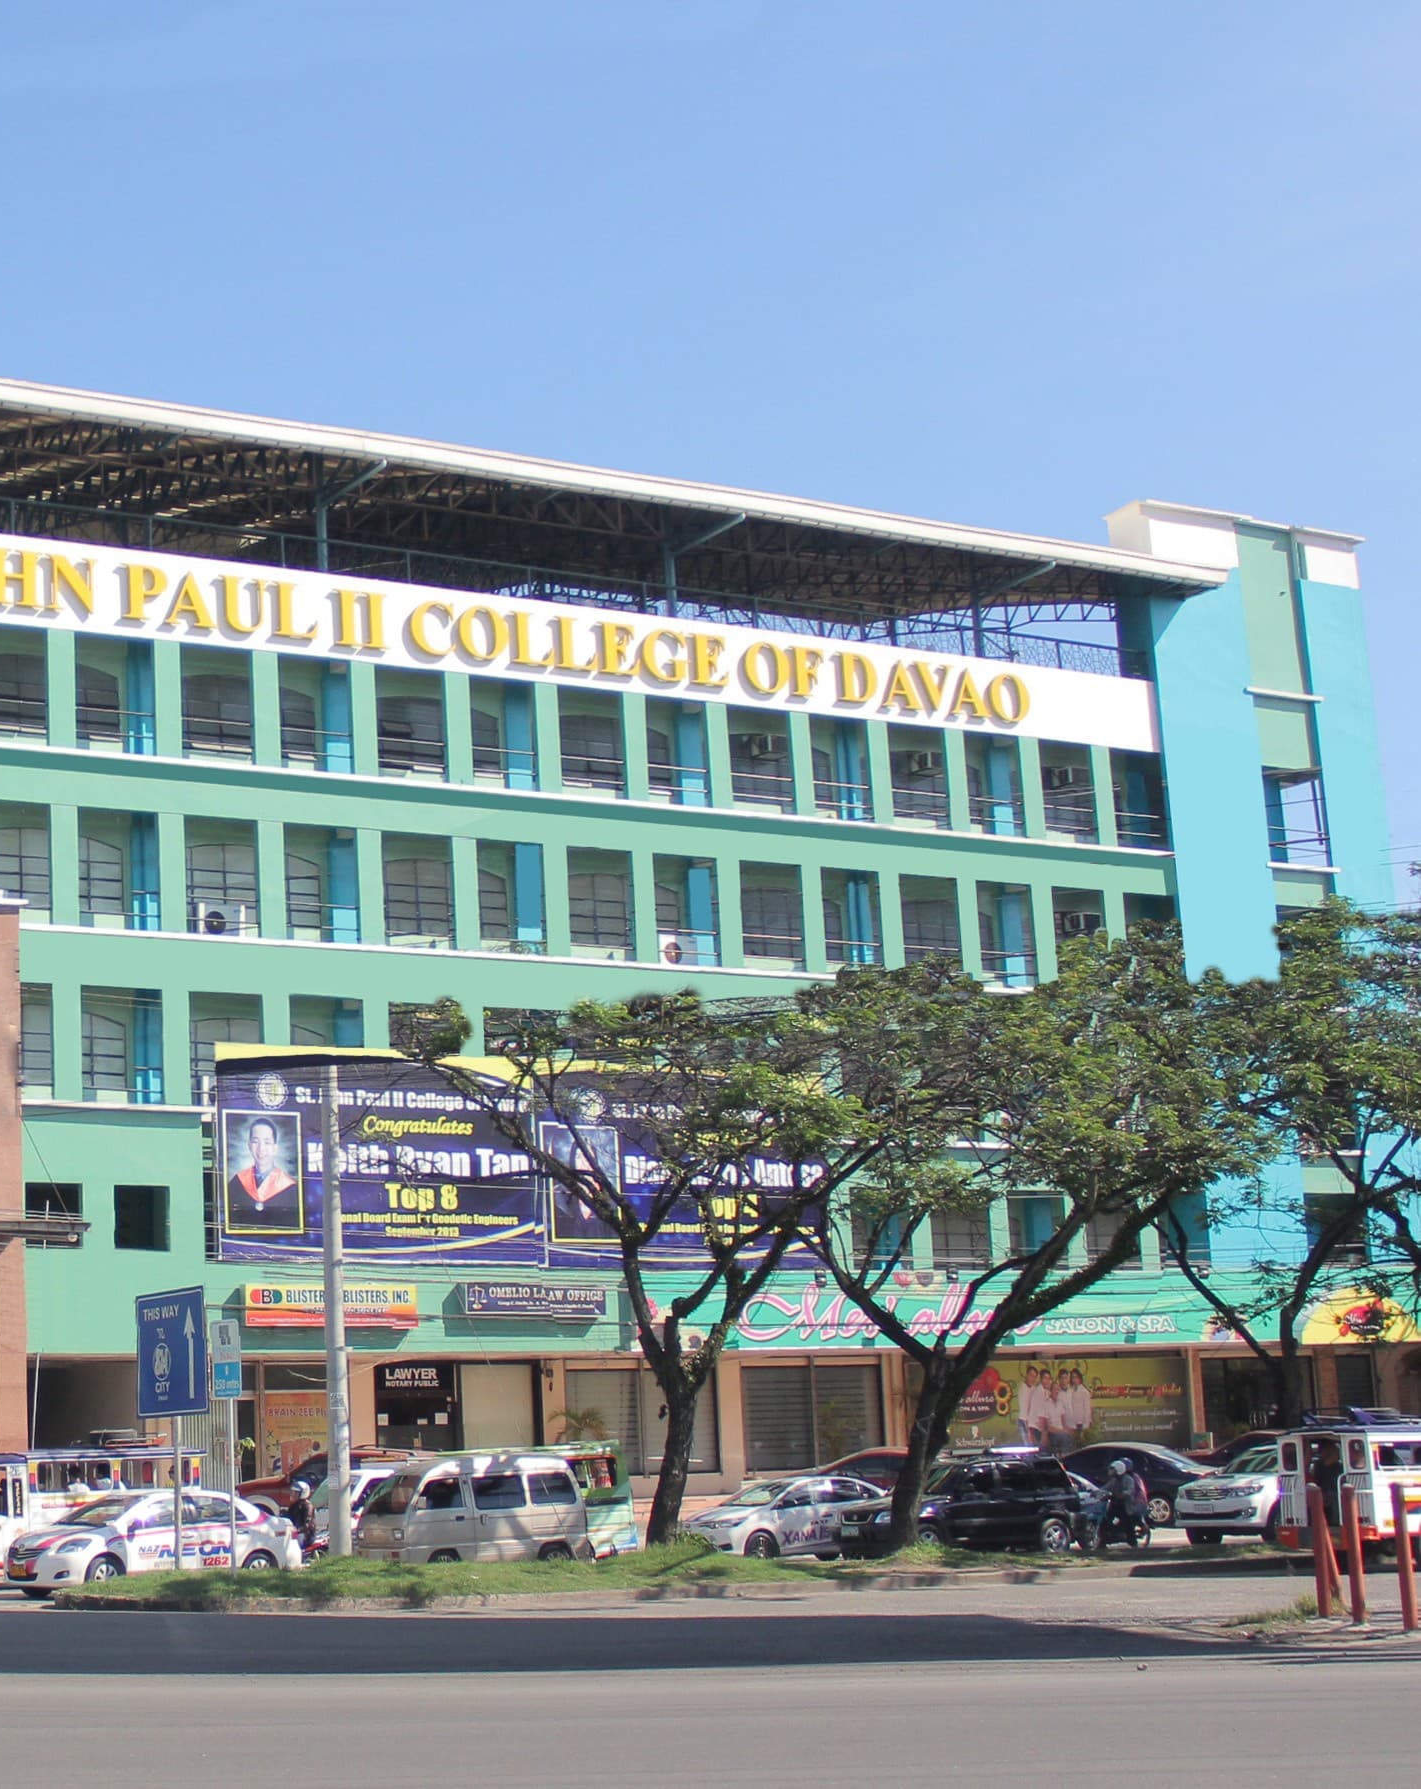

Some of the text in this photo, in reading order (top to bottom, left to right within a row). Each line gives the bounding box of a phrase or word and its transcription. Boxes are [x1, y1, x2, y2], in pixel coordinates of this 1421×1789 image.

[119, 563, 320, 640] PAUL
[330, 588, 388, 650] II
[408, 600, 731, 688] COLLEGE
[743, 641, 825, 698] OF
[834, 651, 1031, 724] DAVAO
[392, 1091, 403, 1107] II
[406, 1092, 464, 1111] College
[363, 1115, 473, 1138] Congratulates
[385, 1183, 458, 1211] Top 8
[362, 1213, 390, 1223] Board
[392, 1213, 415, 1223] Exam
[432, 1215, 472, 1225] Geodetic
[473, 1216, 519, 1227] Engineers
[385, 1227, 435, 1238] September
[489, 1286, 531, 1298] OMELIO
[567, 1290, 604, 1301] OFFICE
[143, 1304, 180, 1321] THIS WAY
[1045, 1315, 1115, 1334] SALON
[1118, 1316, 1136, 1332] &
[1138, 1316, 1176, 1333] SPA
[386, 1368, 437, 1379] LAWYER
[155, 1381, 170, 1393] CITY
[202, 1556, 230, 1567] 1262
